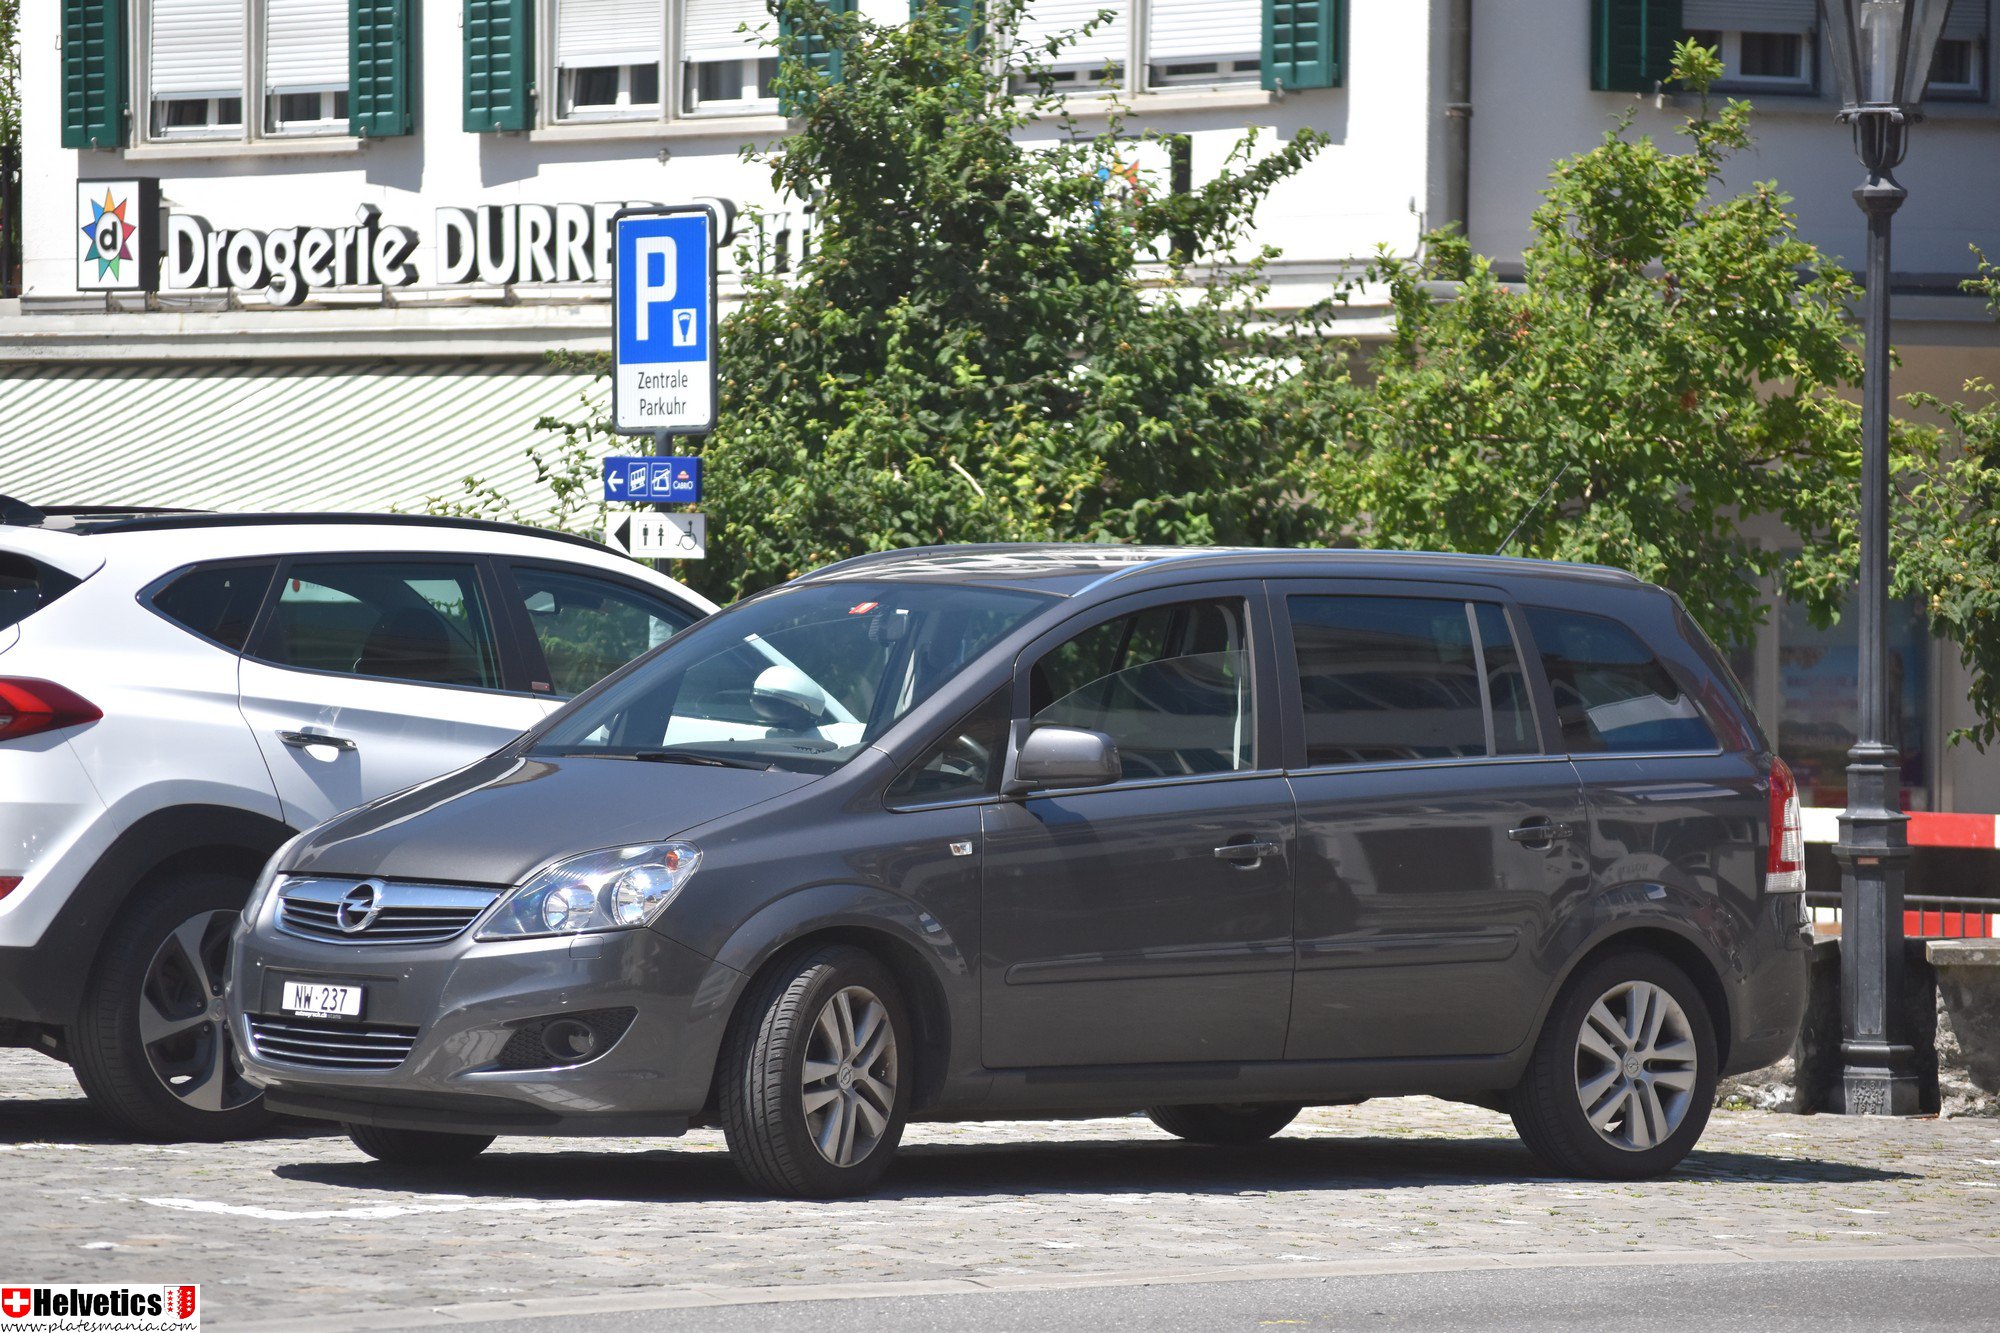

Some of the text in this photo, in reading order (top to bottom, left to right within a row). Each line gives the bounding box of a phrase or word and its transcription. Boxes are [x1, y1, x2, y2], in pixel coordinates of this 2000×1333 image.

[100, 222, 117, 251] d
[168, 203, 420, 306] Drogerie
[635, 236, 678, 341] P
[637, 369, 688, 390] Zentrale
[639, 396, 687, 417] Parkuhr
